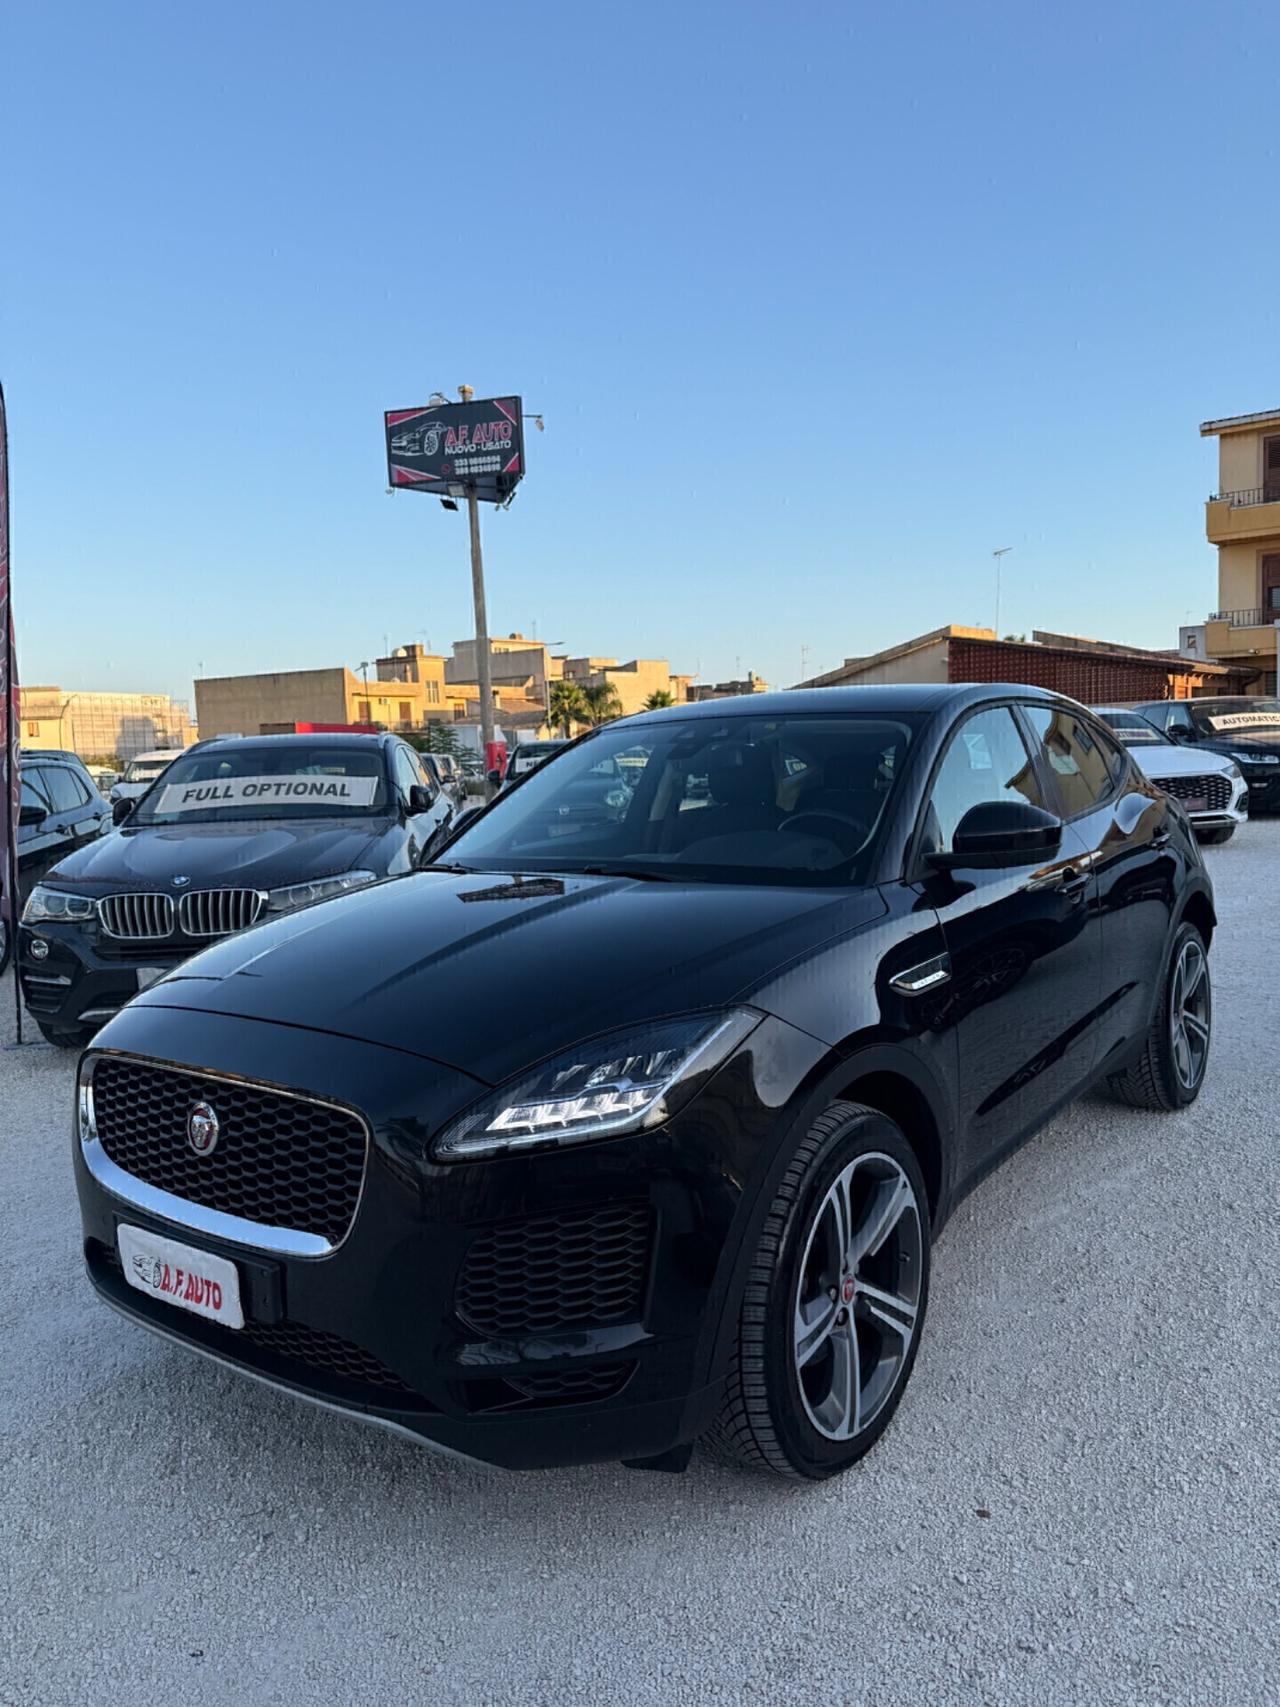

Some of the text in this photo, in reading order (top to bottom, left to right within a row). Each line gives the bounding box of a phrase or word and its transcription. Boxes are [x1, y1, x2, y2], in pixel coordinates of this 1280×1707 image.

[472, 420, 513, 443] AUTO
[445, 440, 512, 455] NUOVO USATO
[181, 781, 351, 803] FULL OPTIONAL
